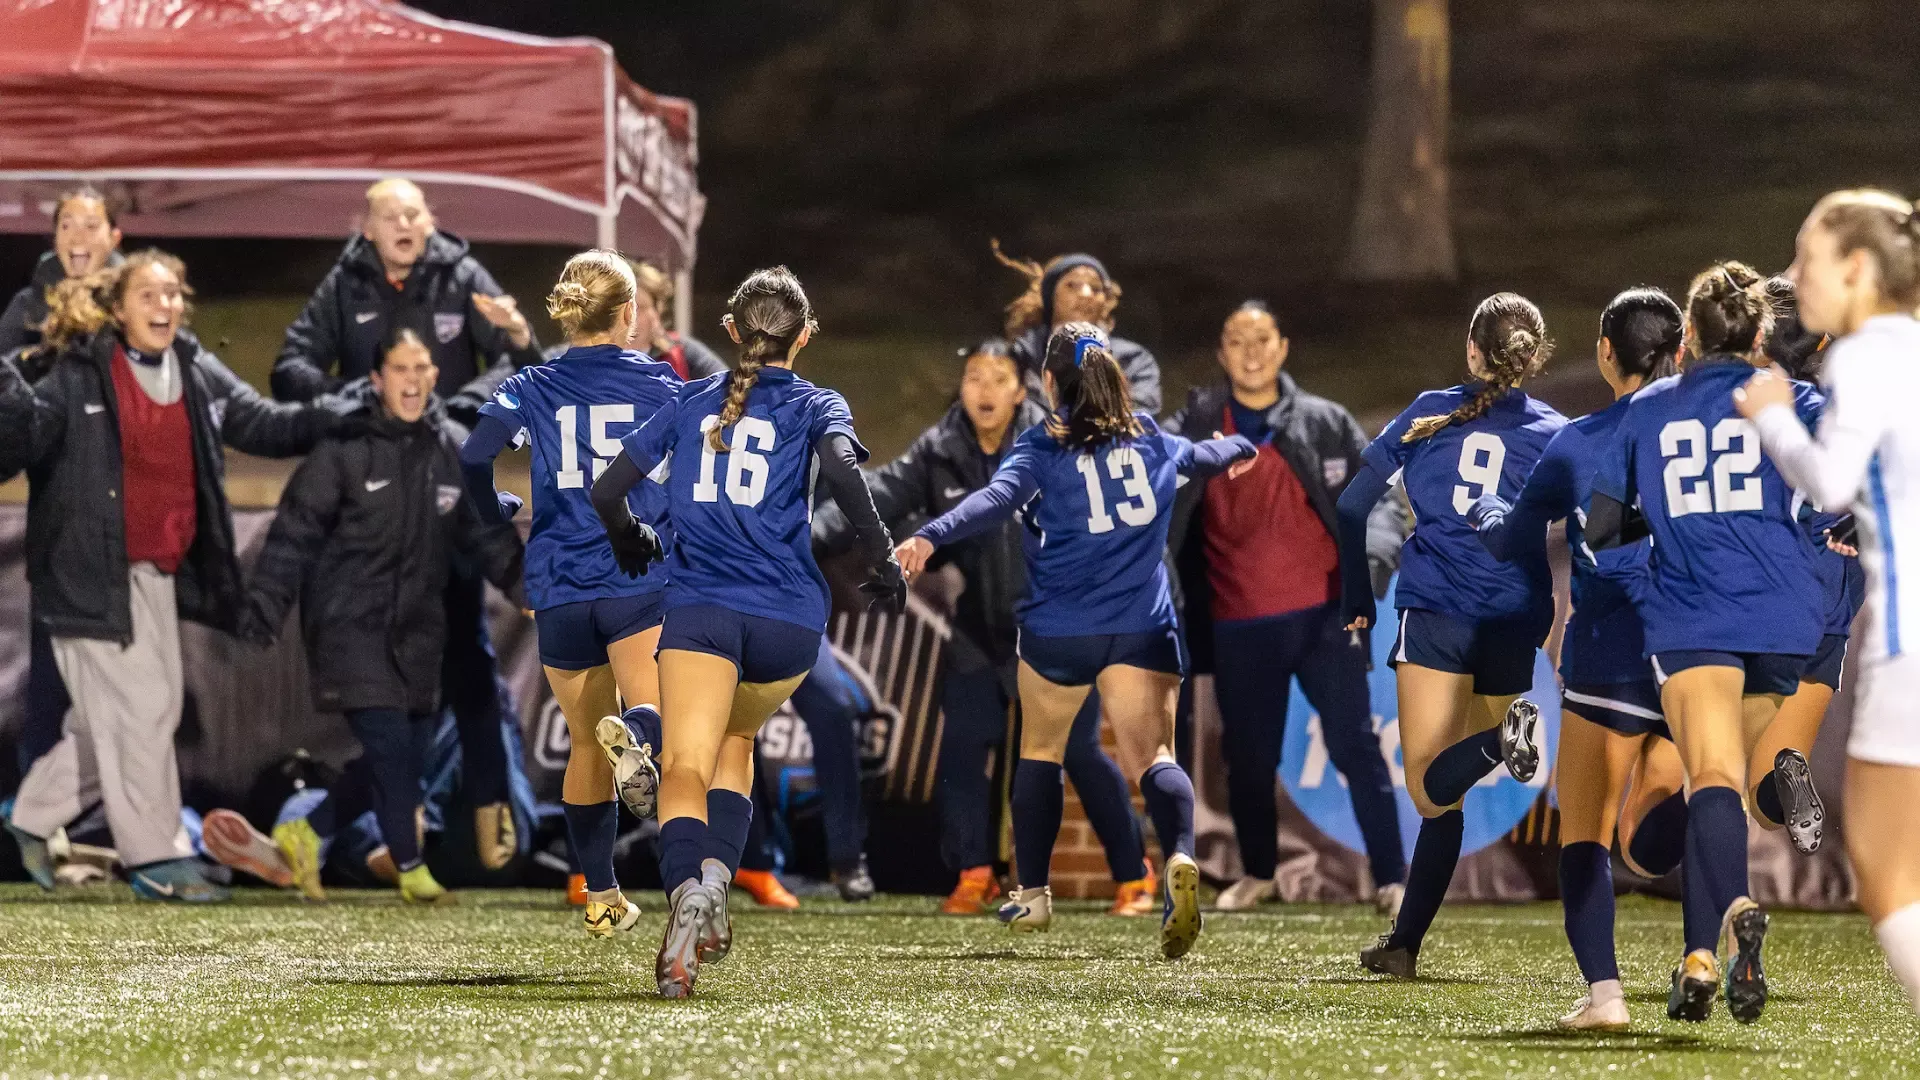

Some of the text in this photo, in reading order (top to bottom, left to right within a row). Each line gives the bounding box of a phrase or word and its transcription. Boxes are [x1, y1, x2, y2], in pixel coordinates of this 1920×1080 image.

[555, 404, 635, 489] 15
[693, 414, 776, 508] 16
[1452, 431, 1506, 516] 9
[1659, 418, 1763, 518] 22
[1076, 447, 1157, 534] 13
